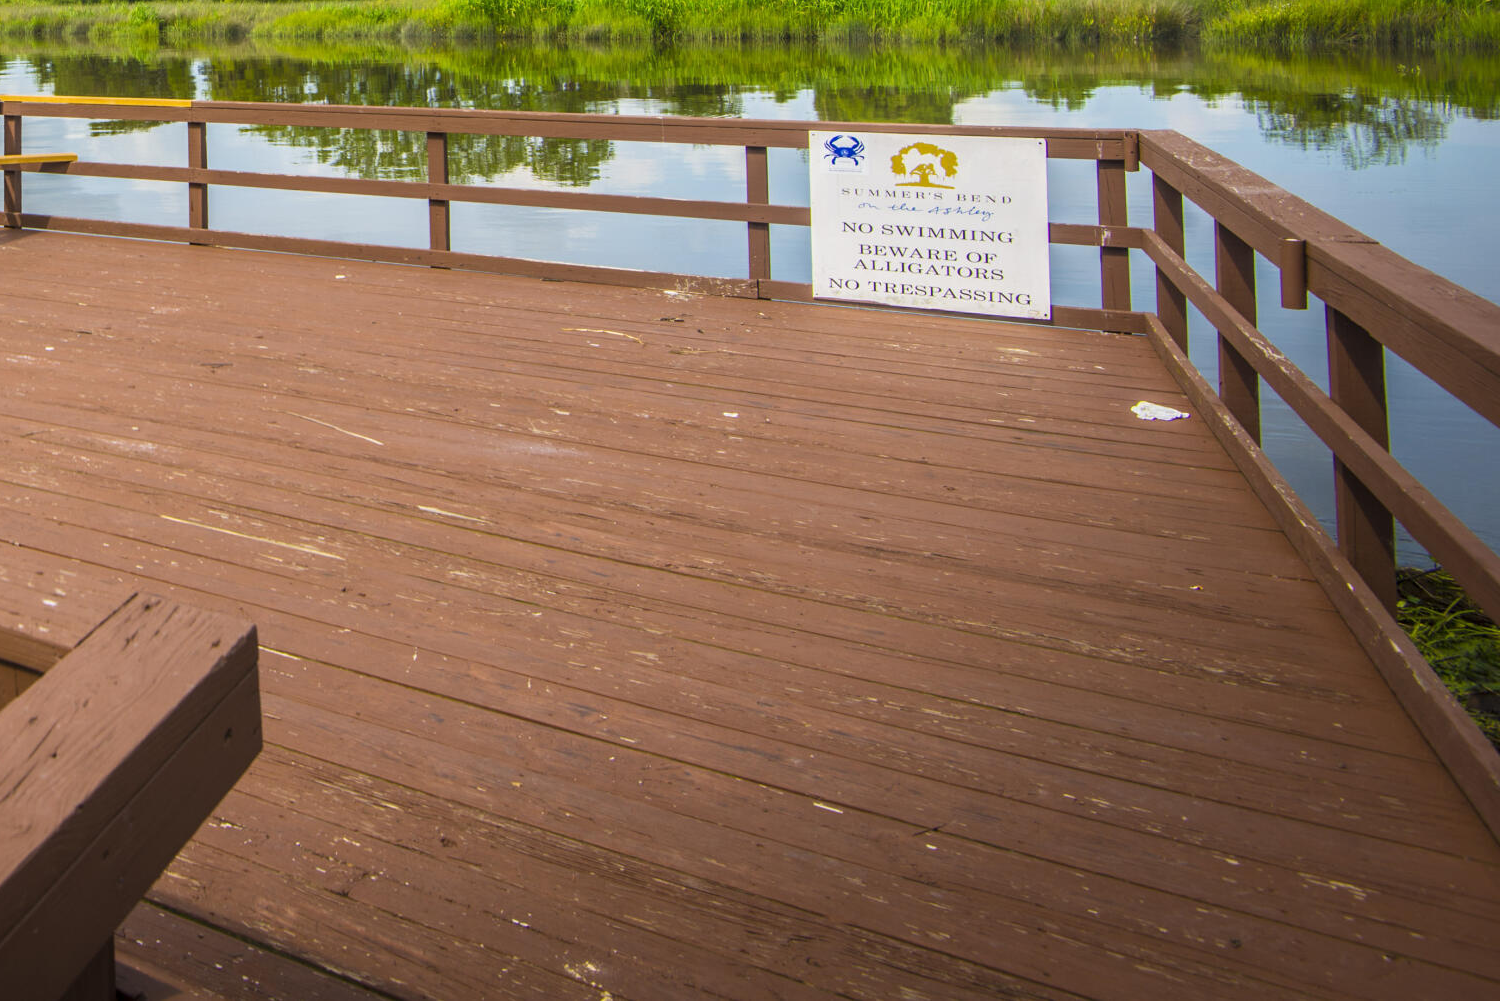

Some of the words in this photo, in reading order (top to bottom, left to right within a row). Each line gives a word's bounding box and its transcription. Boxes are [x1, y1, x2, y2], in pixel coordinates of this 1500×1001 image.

[841, 187, 943, 200] SUMMER'S
[956, 193, 1013, 205] BEND
[858, 201, 880, 210] on
[888, 202, 923, 212] the
[928, 205, 994, 221] Ashley
[842, 221, 873, 235] NO
[881, 224, 1014, 244] SWIMMING
[859, 244, 957, 262] BEWARE
[966, 251, 997, 264] OF
[854, 259, 1004, 281] ALLIGATORS
[829, 277, 859, 290] NO
[868, 281, 1031, 305] TRESPASSING
